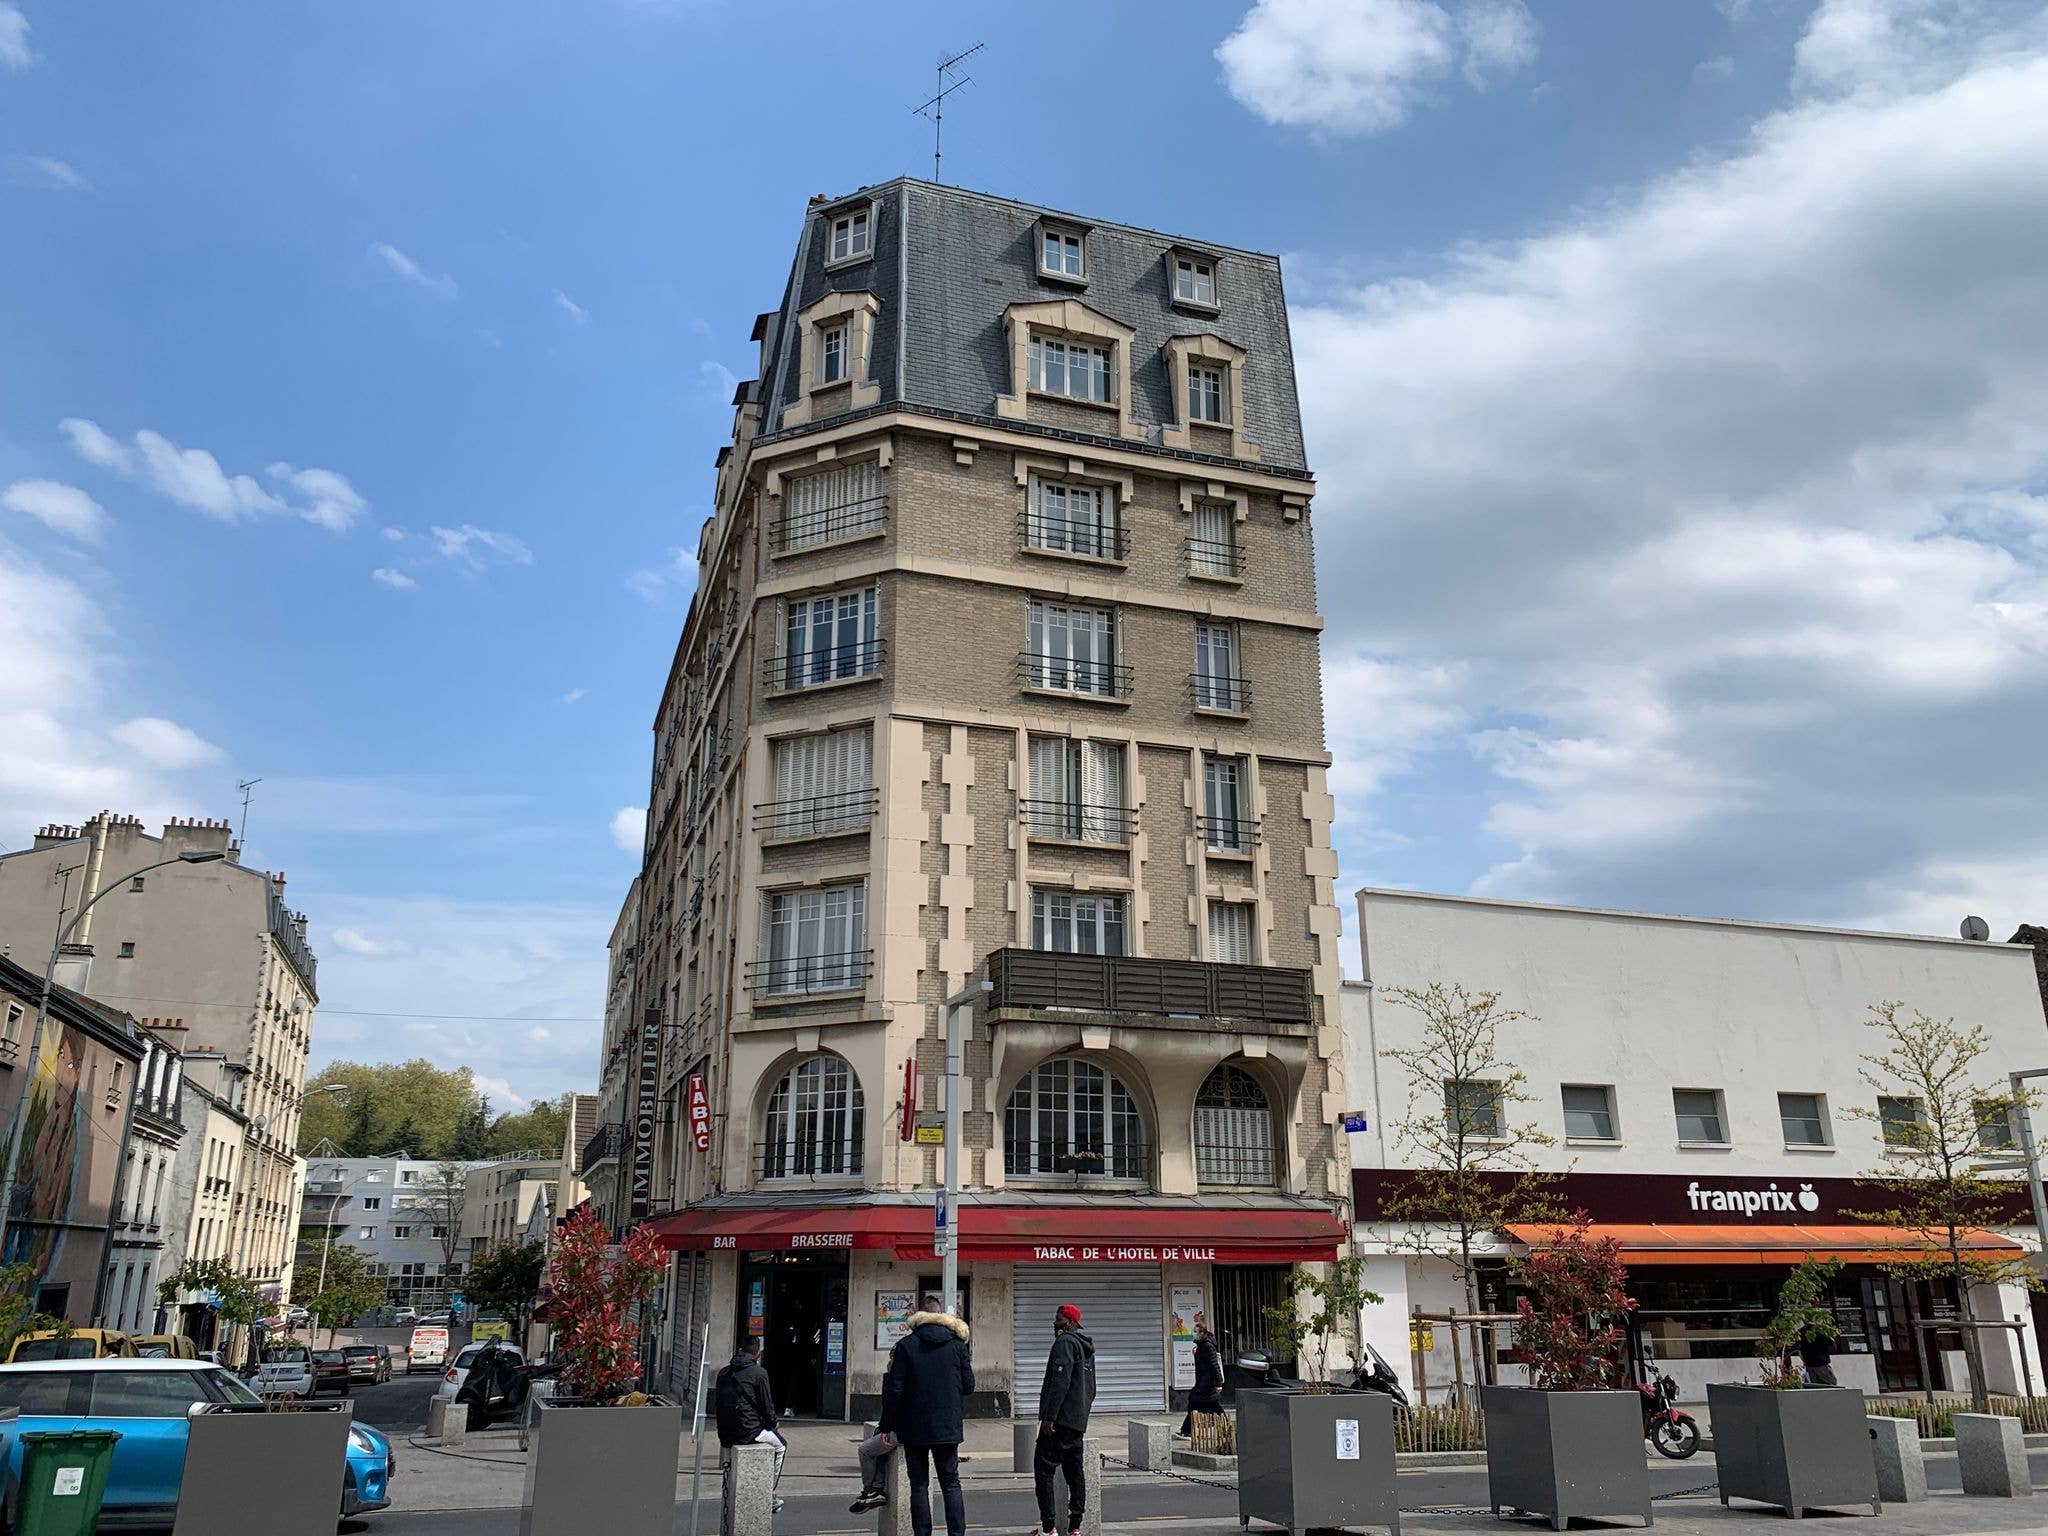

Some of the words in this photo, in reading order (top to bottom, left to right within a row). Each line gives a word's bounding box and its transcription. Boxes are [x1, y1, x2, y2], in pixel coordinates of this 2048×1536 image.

[633, 1023, 660, 1203] IMMOBILIER
[692, 1076, 709, 1149] TABAC
[938, 1196, 944, 1221] P
[1686, 1181, 1797, 1217] franprix
[713, 1236, 736, 1249] BAR
[791, 1233, 853, 1248] BRASSERIE
[1033, 1247, 1075, 1260] TABAC
[1082, 1247, 1100, 1260] DE
[1162, 1247, 1179, 1260] DE
[1183, 1248, 1216, 1260] VILLE
[1486, 1283, 1493, 1293] 3
